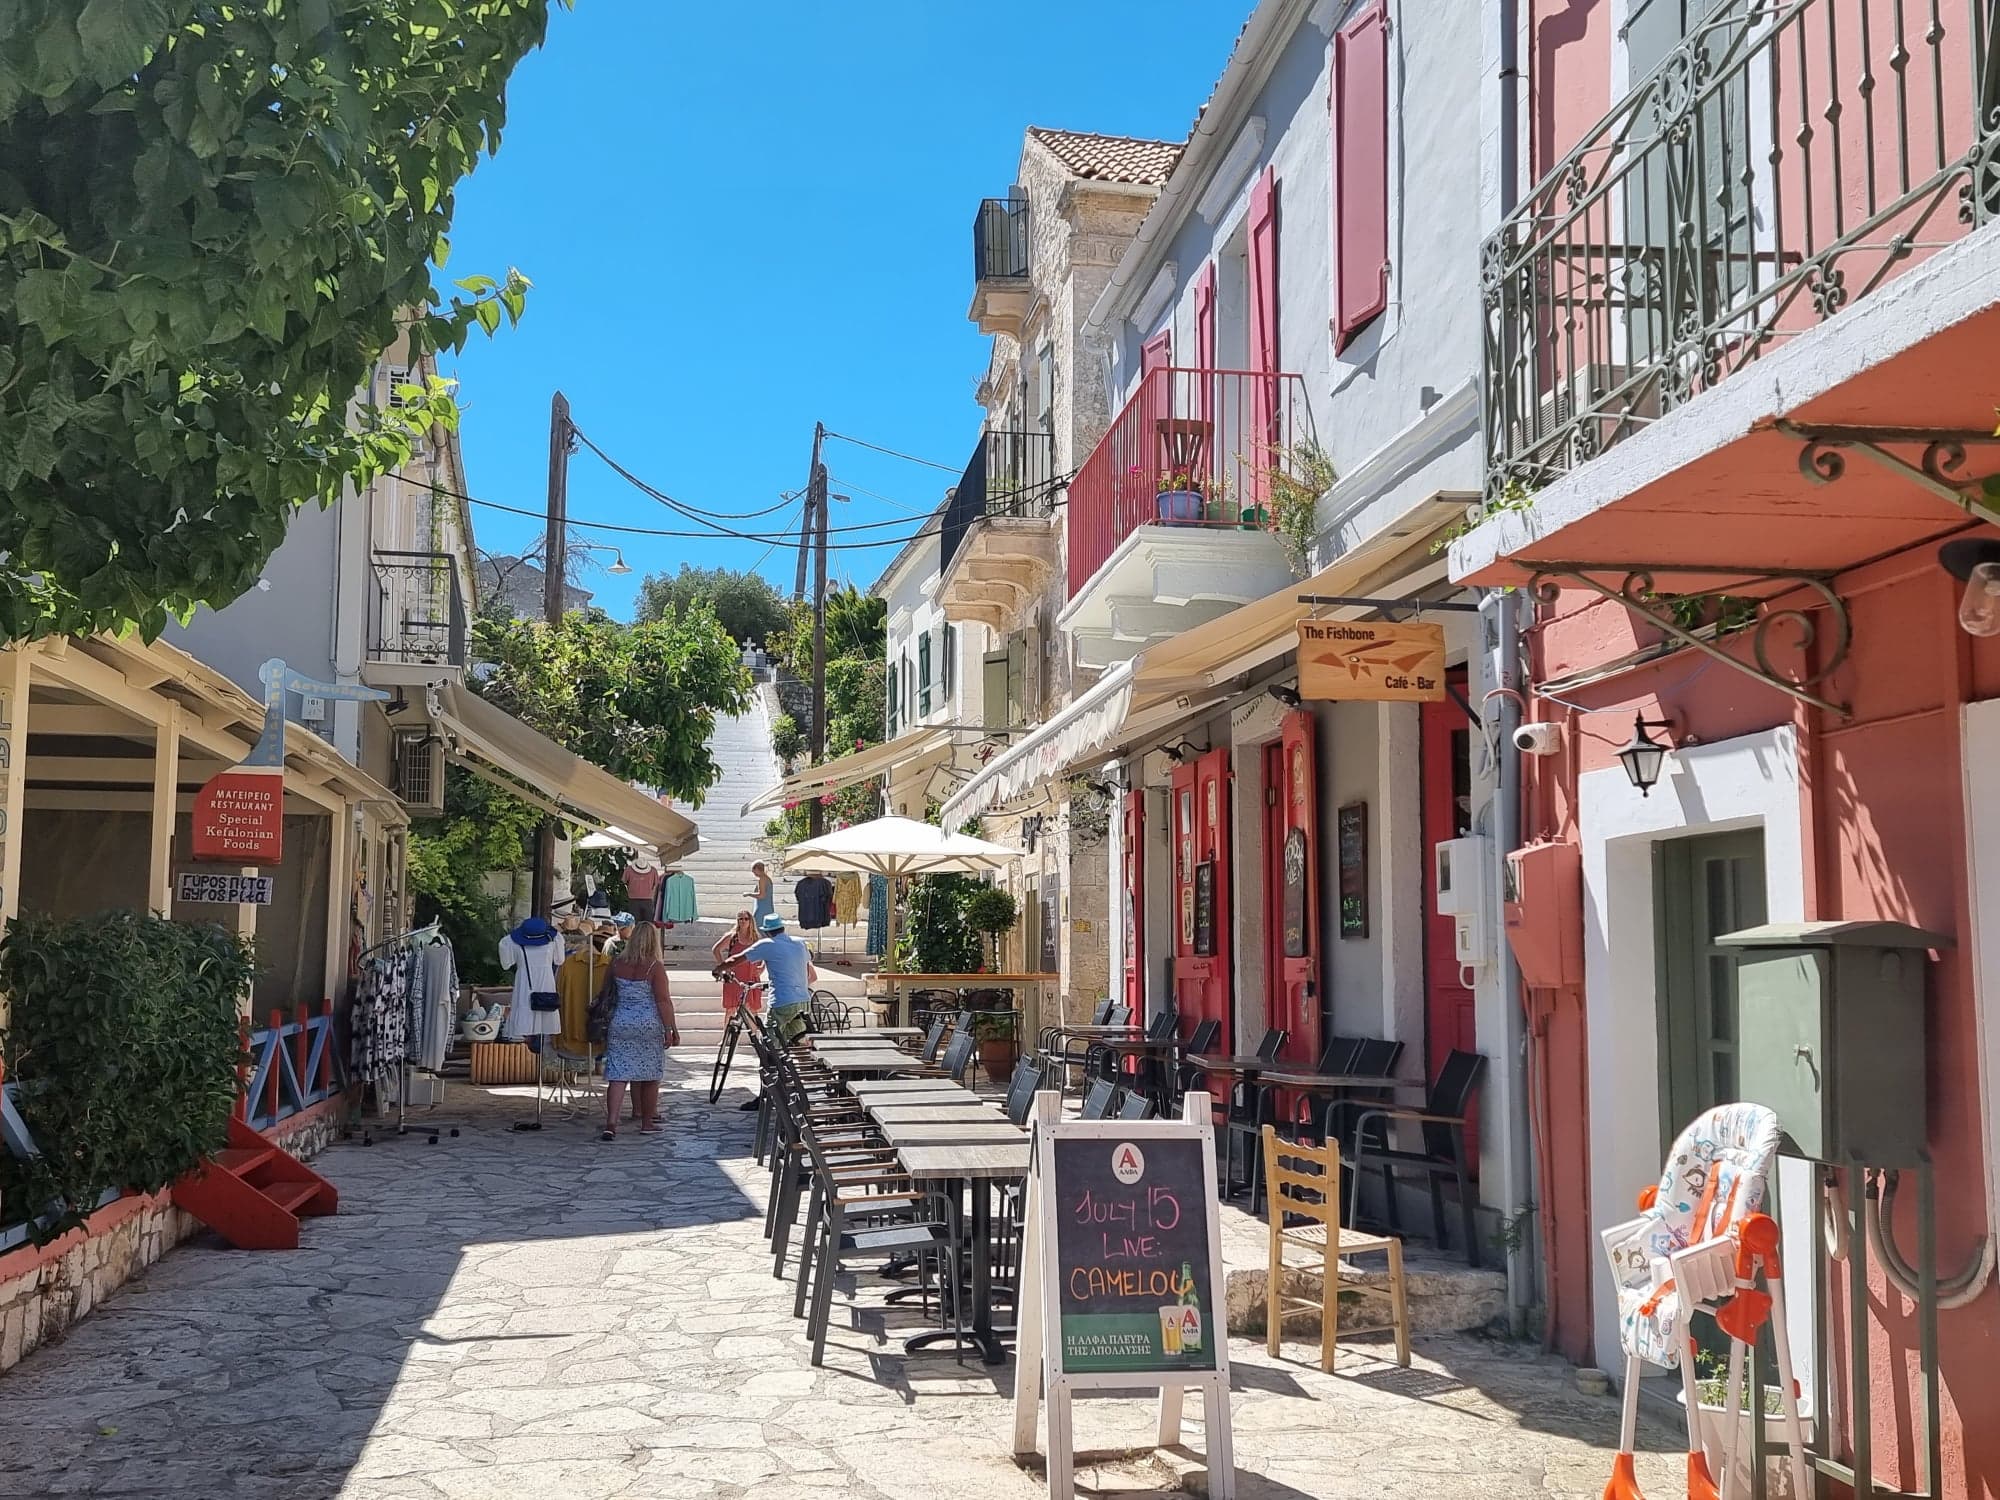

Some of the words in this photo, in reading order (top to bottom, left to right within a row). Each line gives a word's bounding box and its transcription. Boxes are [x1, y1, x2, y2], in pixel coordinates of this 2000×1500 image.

[1304, 626, 1324, 639] The
[1326, 627, 1375, 640] Fishbone
[1385, 675, 1409, 689] Café
[1417, 676, 1436, 690] Bar
[216, 790, 271, 801] ΜΑΓΕΙΡΕΙΟ
[211, 801, 274, 811] RESTAURANT
[219, 813, 263, 825] Special
[206, 826, 274, 839] Kefalonian
[223, 838, 260, 850] Foods
[1075, 1190, 1136, 1231] JULY
[1148, 1186, 1180, 1230] 15
[1078, 1334, 1107, 1345] ΑΛΦΑ
[1109, 1333, 1150, 1345] ΠΛΕΥΡΑ
[1067, 1346, 1088, 1356] ΤΗΣ
[1090, 1345, 1151, 1356] ΑΠΟΛΑΥΣΗΣ
